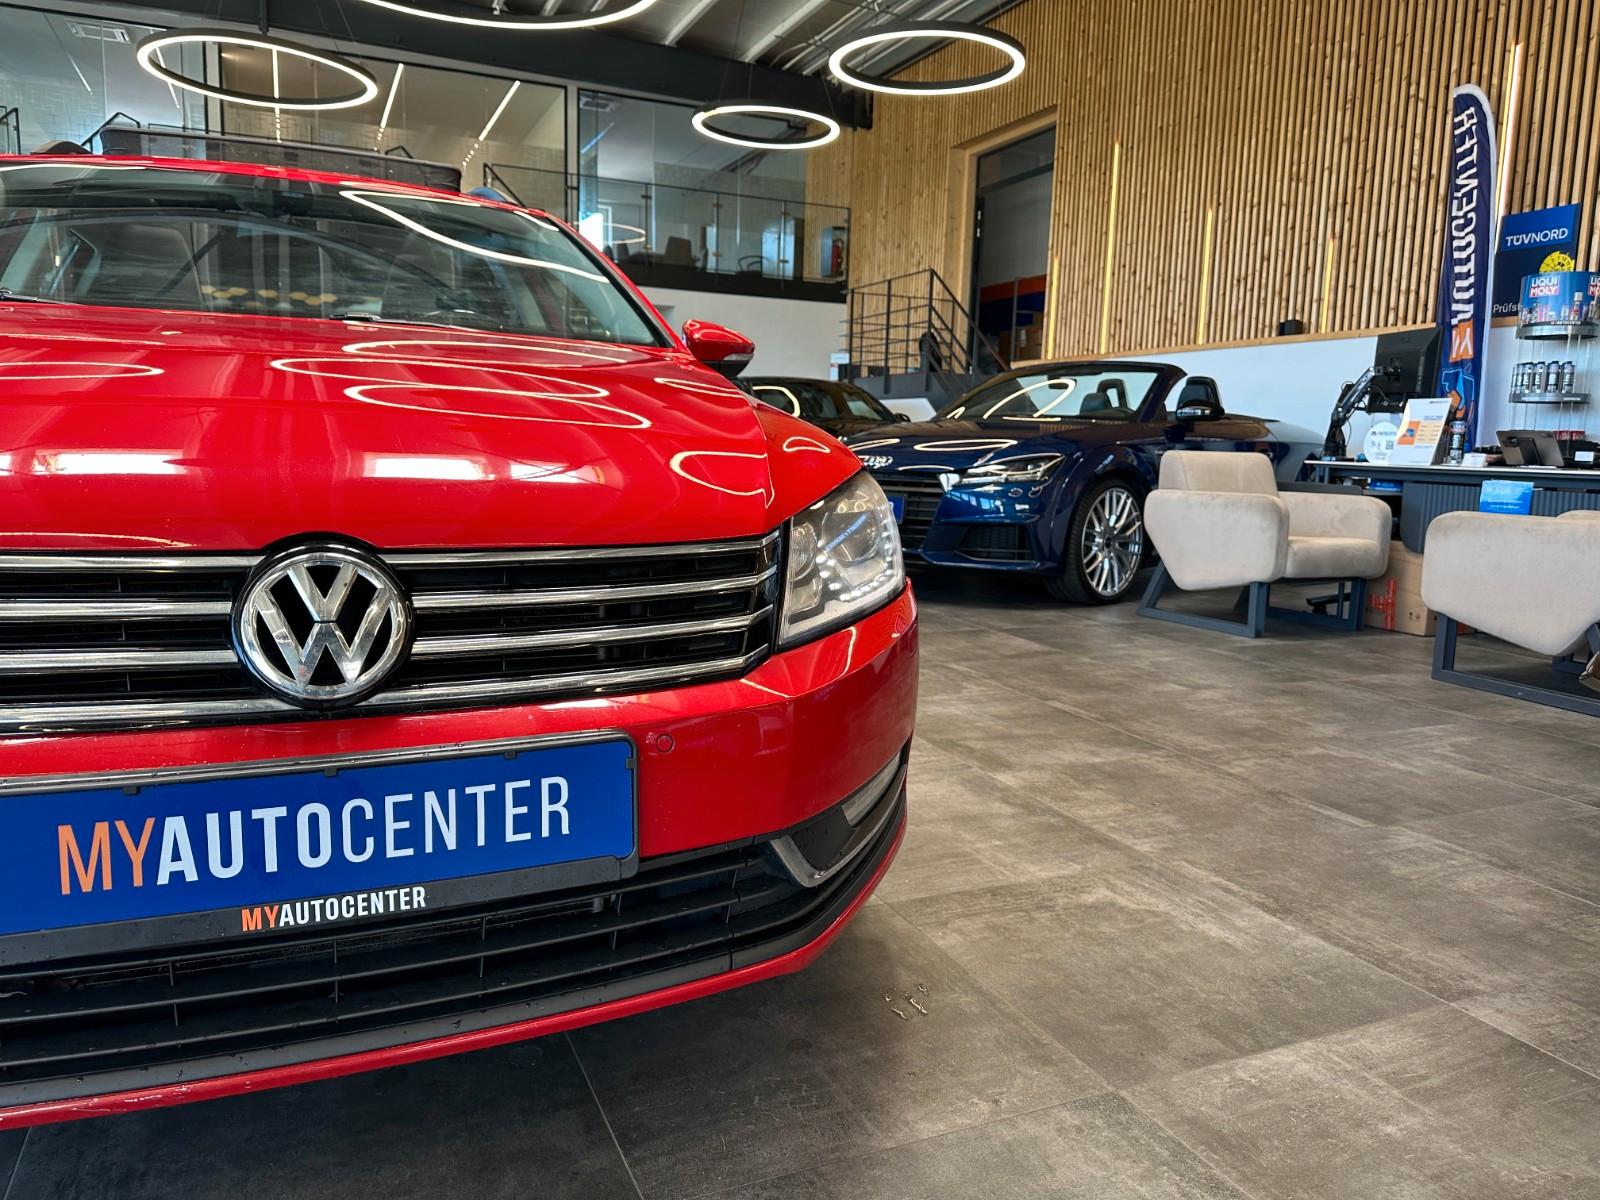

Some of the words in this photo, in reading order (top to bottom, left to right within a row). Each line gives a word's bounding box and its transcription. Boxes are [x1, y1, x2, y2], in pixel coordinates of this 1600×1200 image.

[1505, 228, 1569, 247] TÜVNORD
[1530, 286, 1558, 296] MOLY
[1531, 276, 1558, 287] LIQUI
[252, 560, 396, 695] VW
[57, 775, 571, 895] MYAUTOCENTER
[241, 886, 426, 932] MYAUTOCENTER
